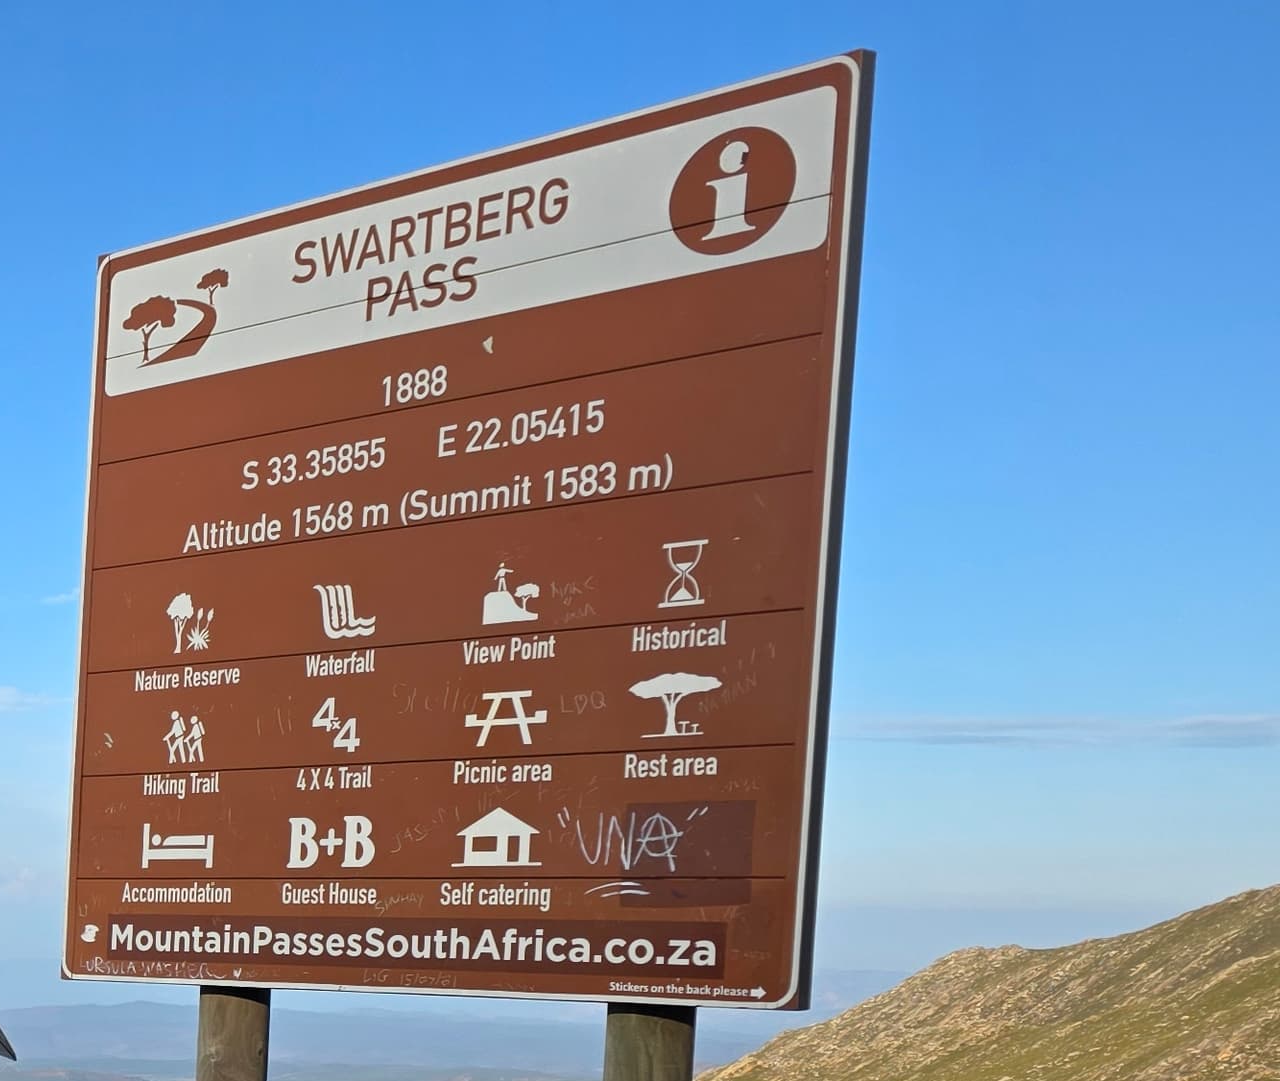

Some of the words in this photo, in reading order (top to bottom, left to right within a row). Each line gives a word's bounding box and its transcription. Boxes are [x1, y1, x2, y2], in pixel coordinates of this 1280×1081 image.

[292, 178, 568, 283] SWARTBERG
[365, 256, 478, 322] PASS
[383, 366, 447, 406] 1888
[242, 461, 259, 489] S
[267, 438, 385, 485] 33.35855
[438, 424, 457, 457] E
[466, 400, 604, 452] 22.05415
[183, 513, 281, 553] Altitude
[293, 501, 353, 537] 1568
[362, 504, 388, 527] m
[401, 475, 531, 525] (Summit
[544, 462, 616, 501] 1583
[629, 454, 672, 490] m)
[632, 620, 726, 651] Historical
[306, 650, 374, 677] Waterfall
[463, 641, 505, 664] View
[510, 636, 555, 661] Point
[135, 671, 179, 691] Nature
[184, 667, 240, 687] Reserve
[297, 769, 306, 790] 4
[310, 768, 320, 790] X
[325, 768, 334, 789] 4
[339, 766, 371, 788] Trail
[454, 760, 506, 784] Picnic
[512, 764, 551, 781] area
[625, 754, 667, 778] Rest
[673, 757, 717, 776] area
[144, 775, 186, 799] Hiking
[190, 772, 219, 793] Trail
[287, 816, 375, 868] B+B
[122, 883, 231, 902] Accommodation
[282, 883, 325, 904] Guest
[329, 883, 376, 904] House
[440, 882, 474, 905] Self
[479, 882, 550, 911] catering
[110, 924, 716, 966] MountainPassesSouthAfrica.co.za
[609, 981, 649, 993] Stickers
[650, 984, 665, 994] on
[666, 984, 685, 994] the
[685, 984, 711, 996] back
[713, 985, 749, 998] please
